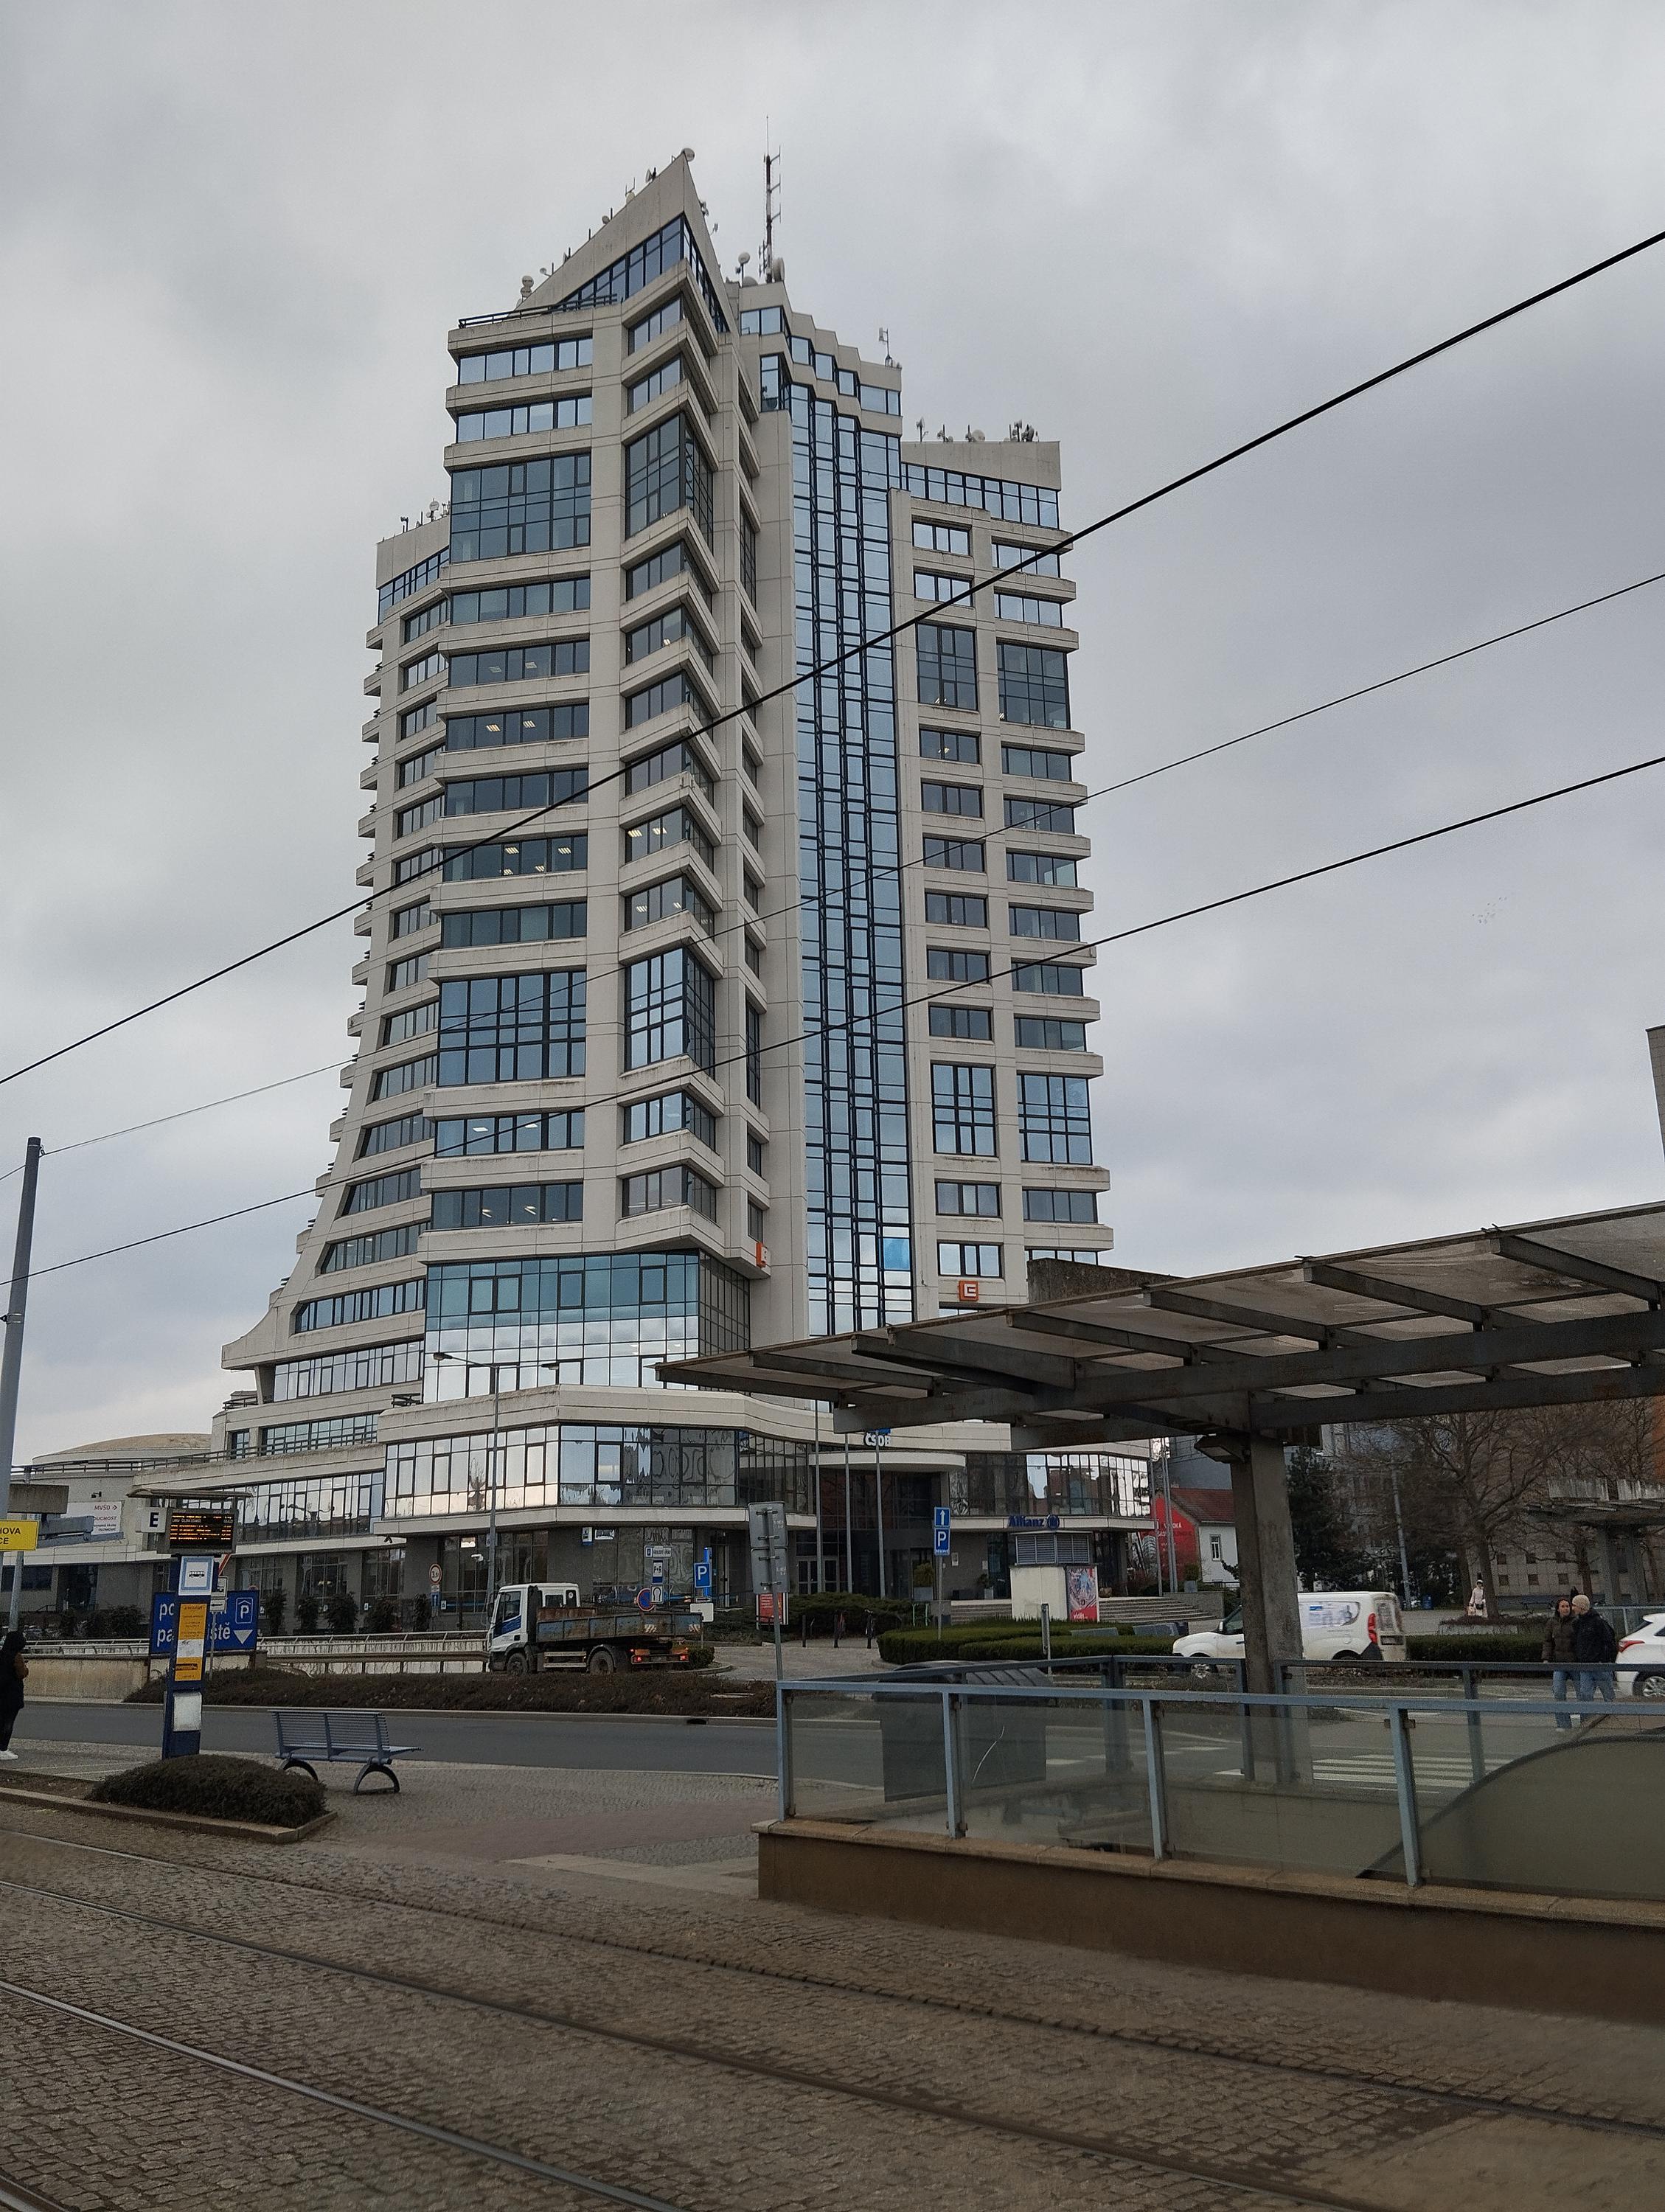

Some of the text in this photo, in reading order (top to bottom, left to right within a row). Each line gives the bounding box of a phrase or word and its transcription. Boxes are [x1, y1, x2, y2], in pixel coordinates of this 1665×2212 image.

[865, 1433, 891, 1447] ČSOB
[150, 1512, 159, 1528] E
[1008, 1515, 1045, 1527] Allianz
[938, 1531, 946, 1548] P
[698, 1566, 707, 1580] P
